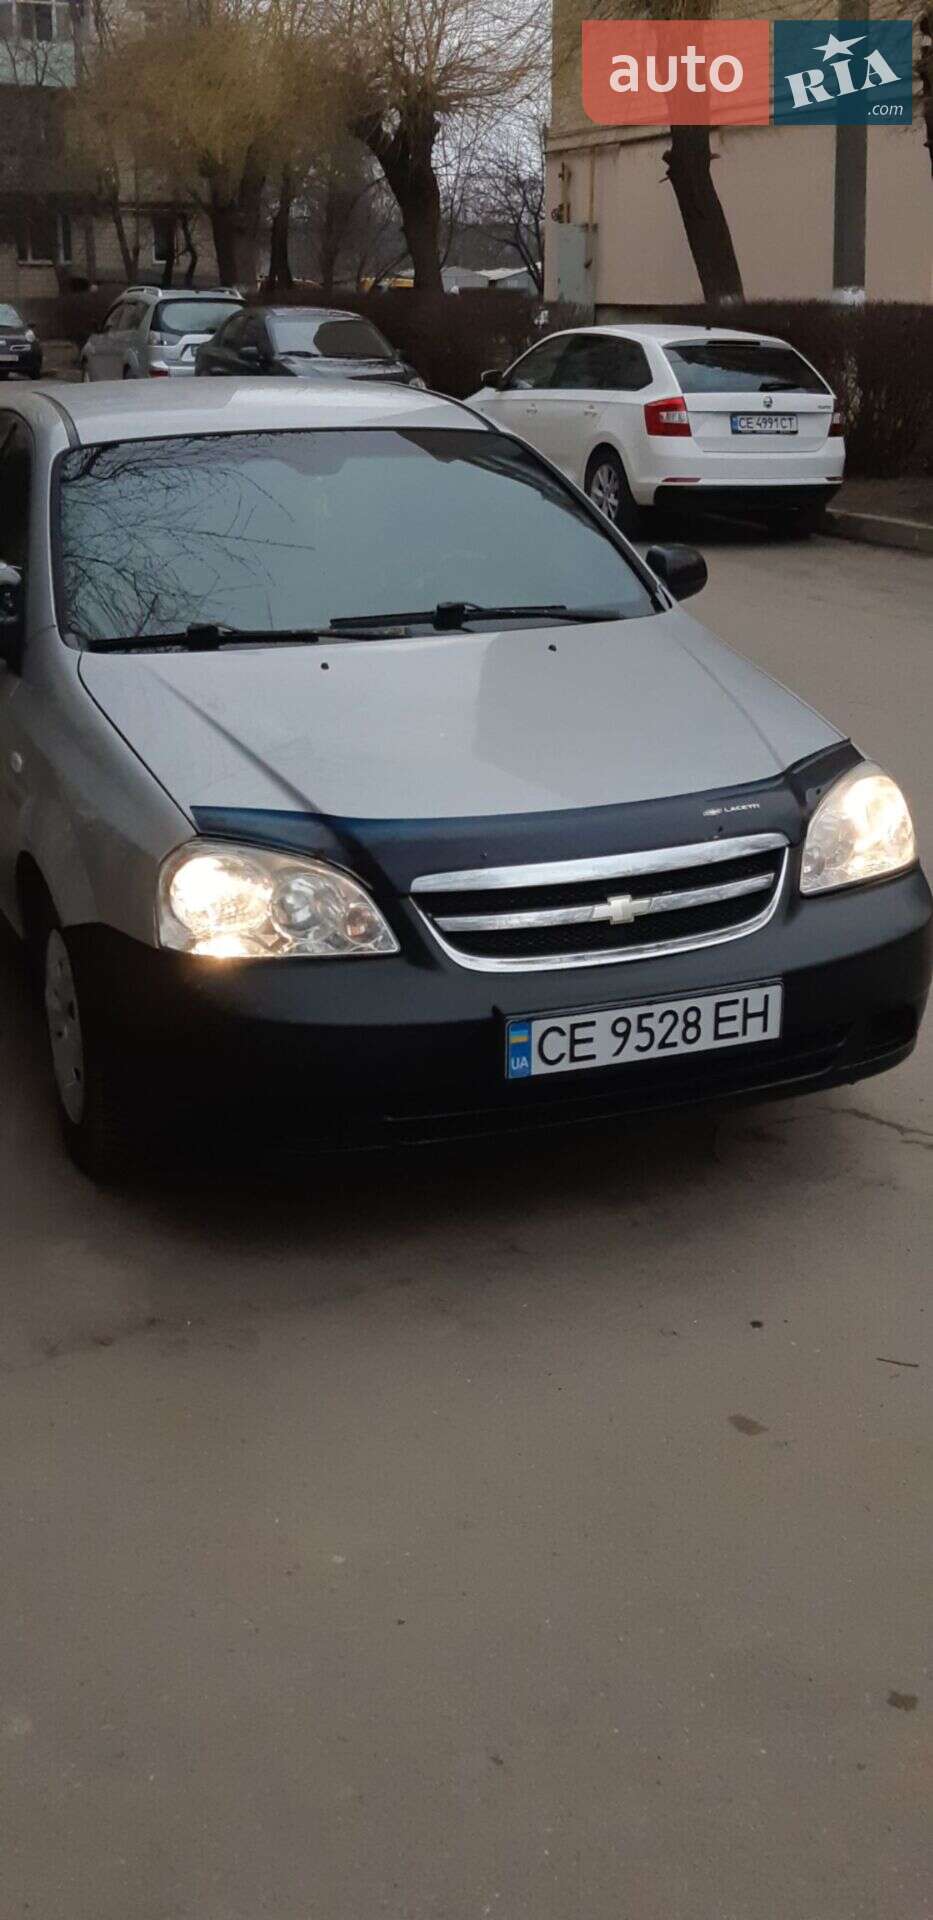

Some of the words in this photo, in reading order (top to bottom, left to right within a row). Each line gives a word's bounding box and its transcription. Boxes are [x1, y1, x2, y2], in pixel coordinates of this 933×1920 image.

[739, 417, 753, 429] CE
[780, 417, 794, 429] CT
[537, 1020, 597, 1066] CE
[610, 1006, 702, 1057] 9528
[713, 994, 770, 1041] EH
[511, 1056, 529, 1070] UA
